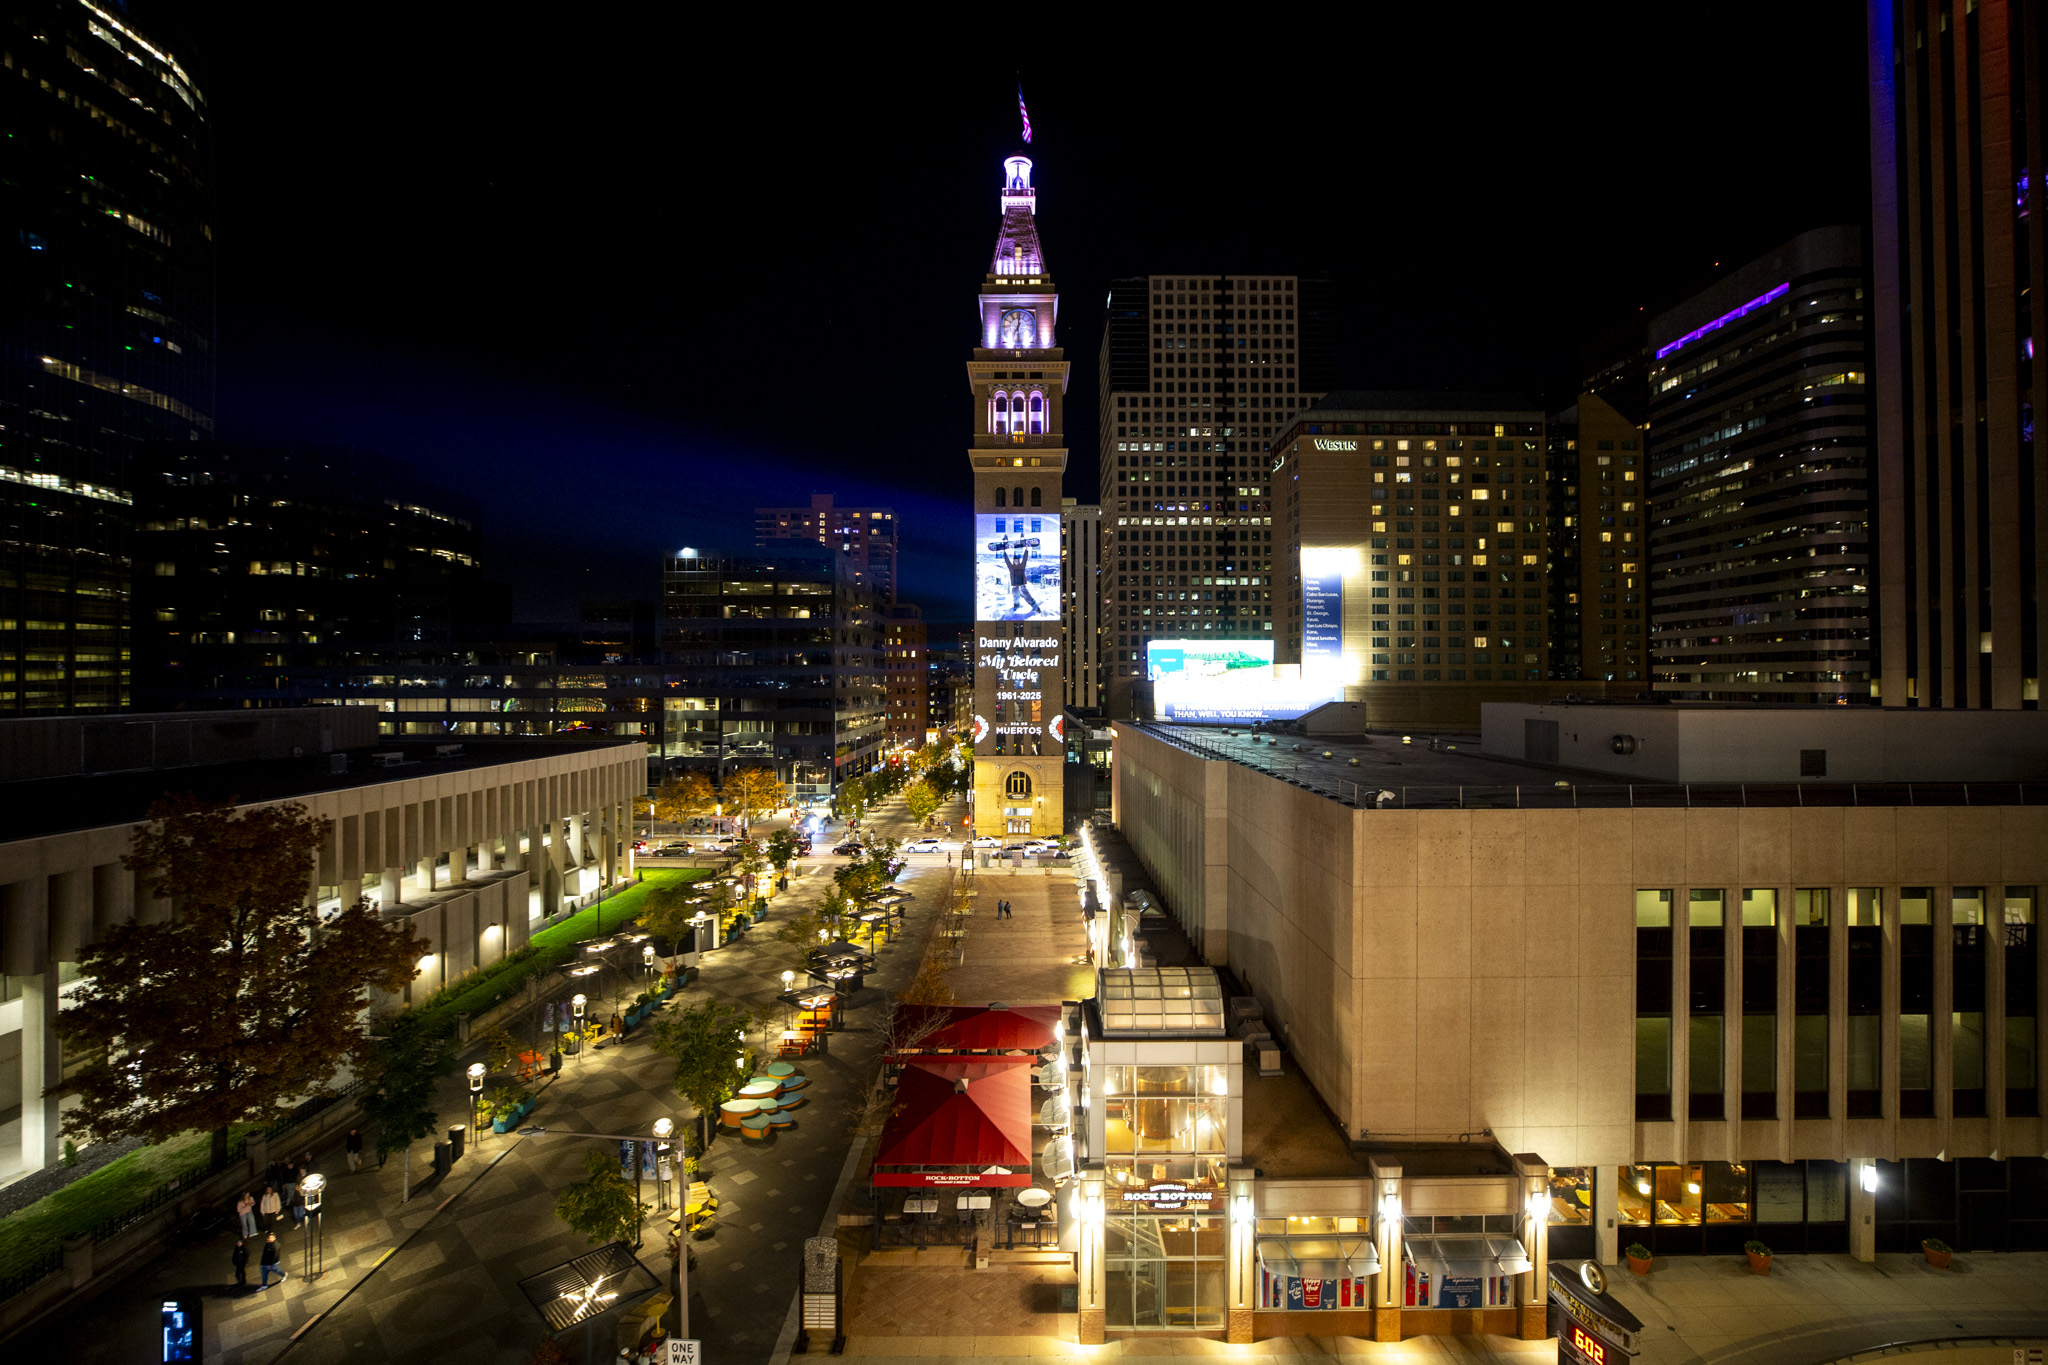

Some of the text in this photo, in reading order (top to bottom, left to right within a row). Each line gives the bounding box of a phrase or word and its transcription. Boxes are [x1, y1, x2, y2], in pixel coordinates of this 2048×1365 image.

[1313, 439, 1357, 451] WESTIN
[980, 637, 1058, 650] Danny Alvarado
[979, 654, 1059, 669] My Beloved
[1000, 668, 1038, 682] Uncle
[996, 691, 1042, 700] 1961-2025
[1174, 710, 1198, 719] THAN,
[1220, 710, 1237, 718] YOU
[996, 727, 1042, 735] MUERTOS
[1123, 1192, 1213, 1201] ROCK BOTTOM
[1568, 1303, 1598, 1331] PLAZA
[671, 1343, 694, 1354] ONE
[672, 1354, 695, 1365] WAY
